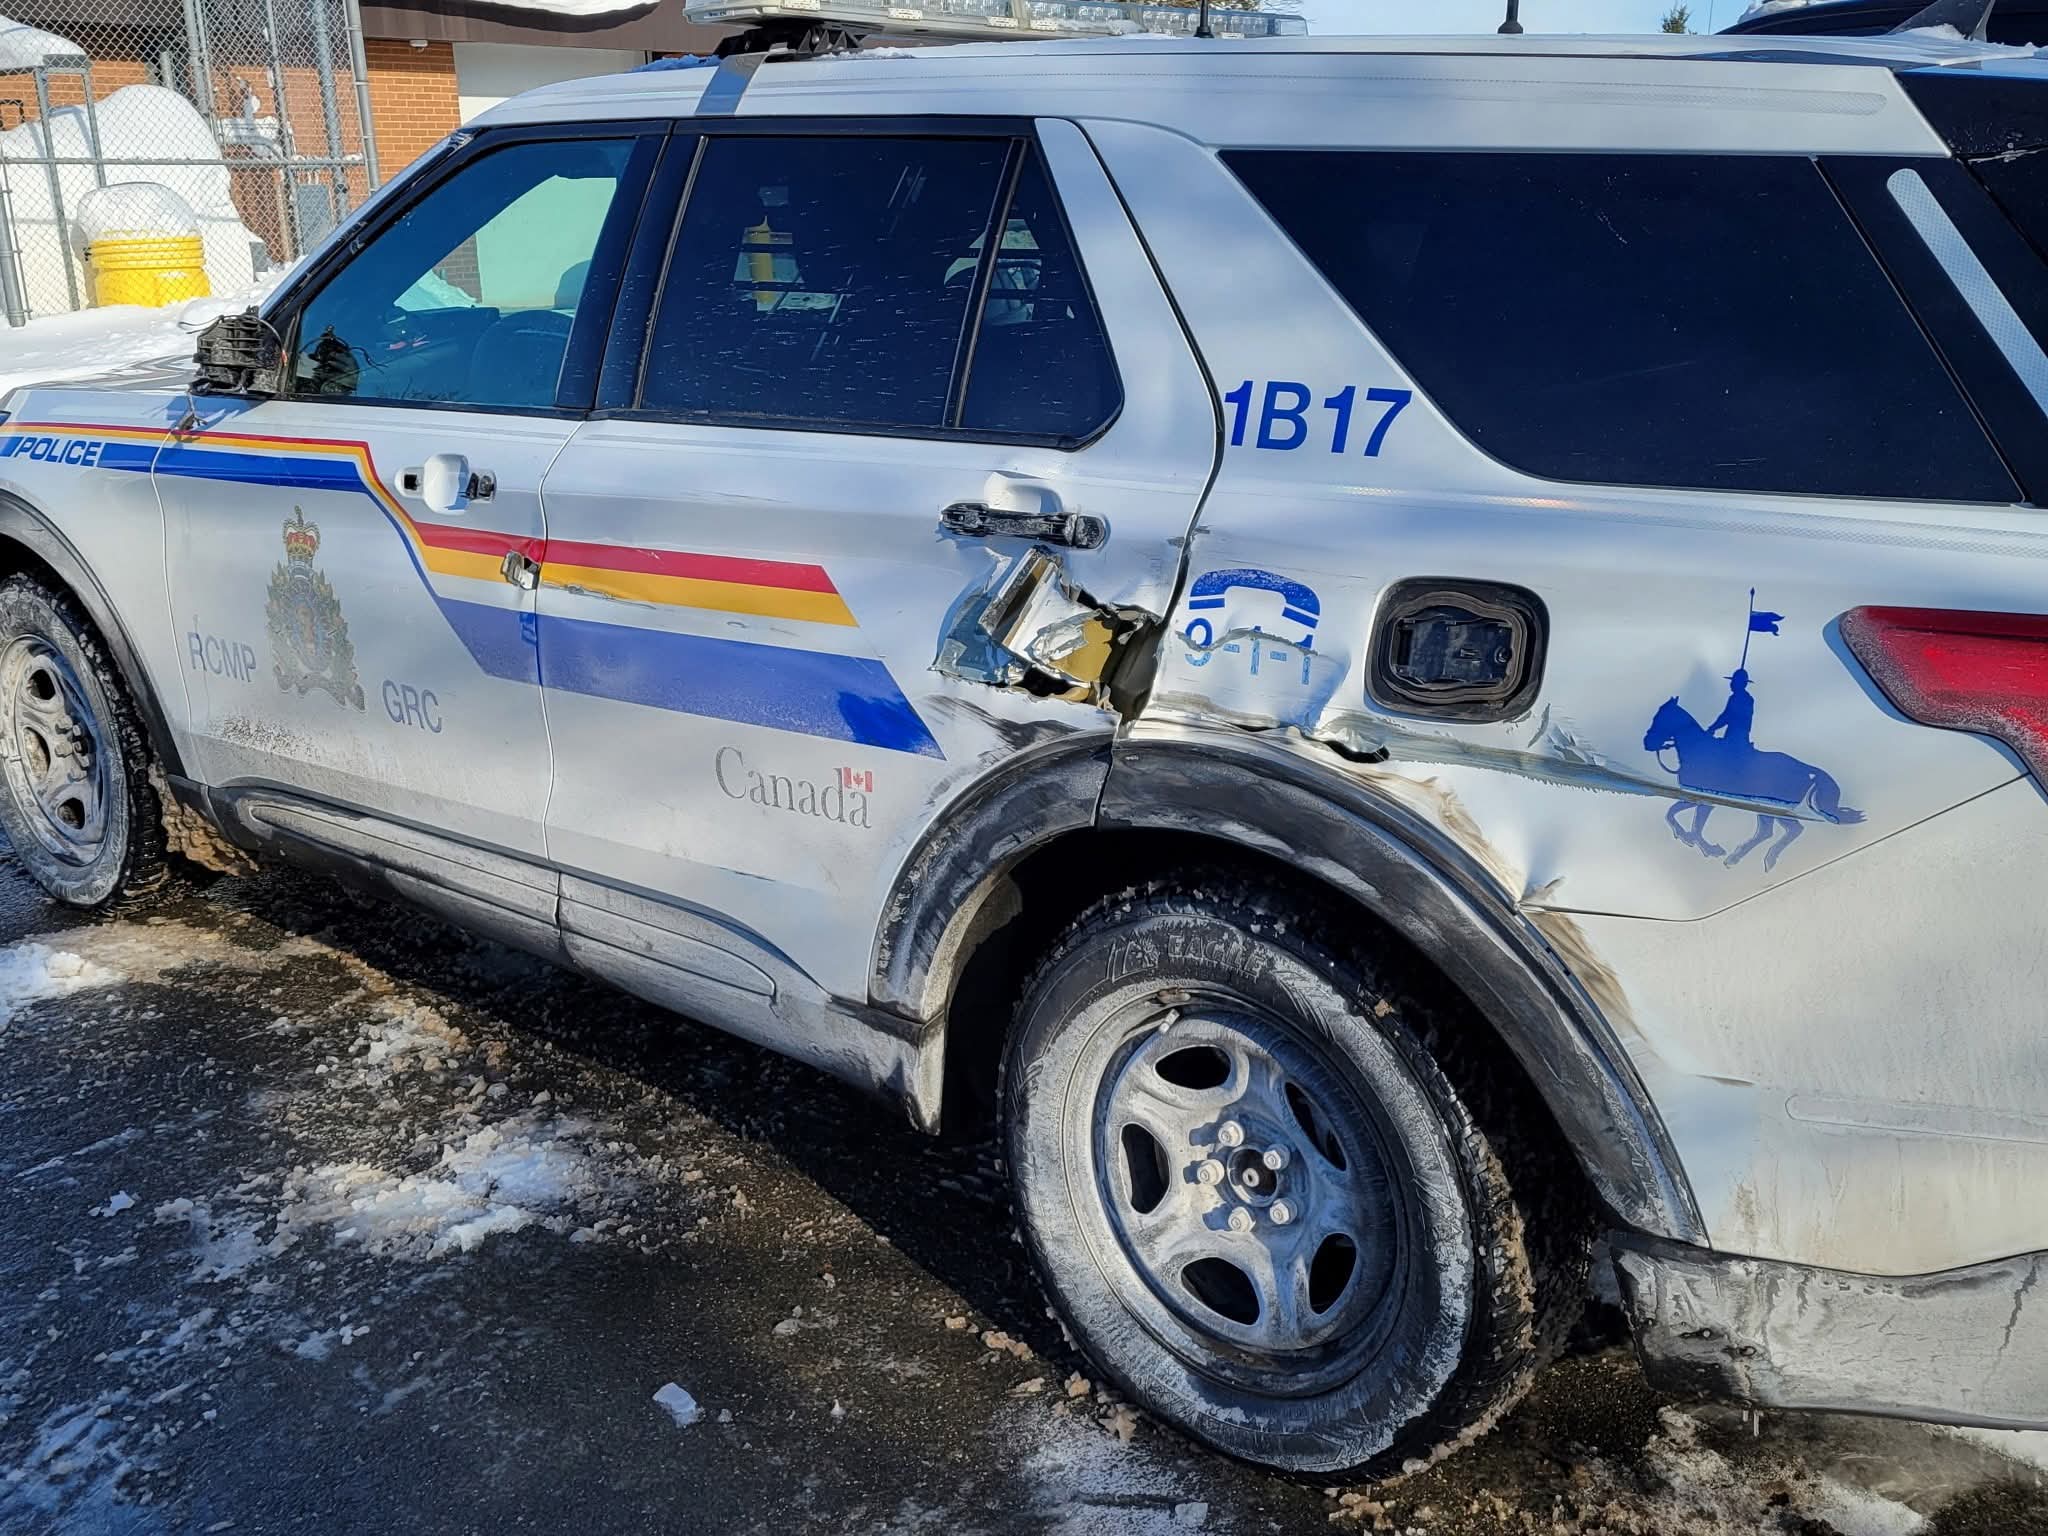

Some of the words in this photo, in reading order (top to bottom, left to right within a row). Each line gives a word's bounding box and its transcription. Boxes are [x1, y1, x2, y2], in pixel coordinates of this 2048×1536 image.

[1224, 380, 1413, 458] 1B17
[13, 436, 102, 467] POLICE
[187, 631, 257, 683] RCMP
[382, 679, 442, 734] GRC
[715, 746, 873, 829] Canada
